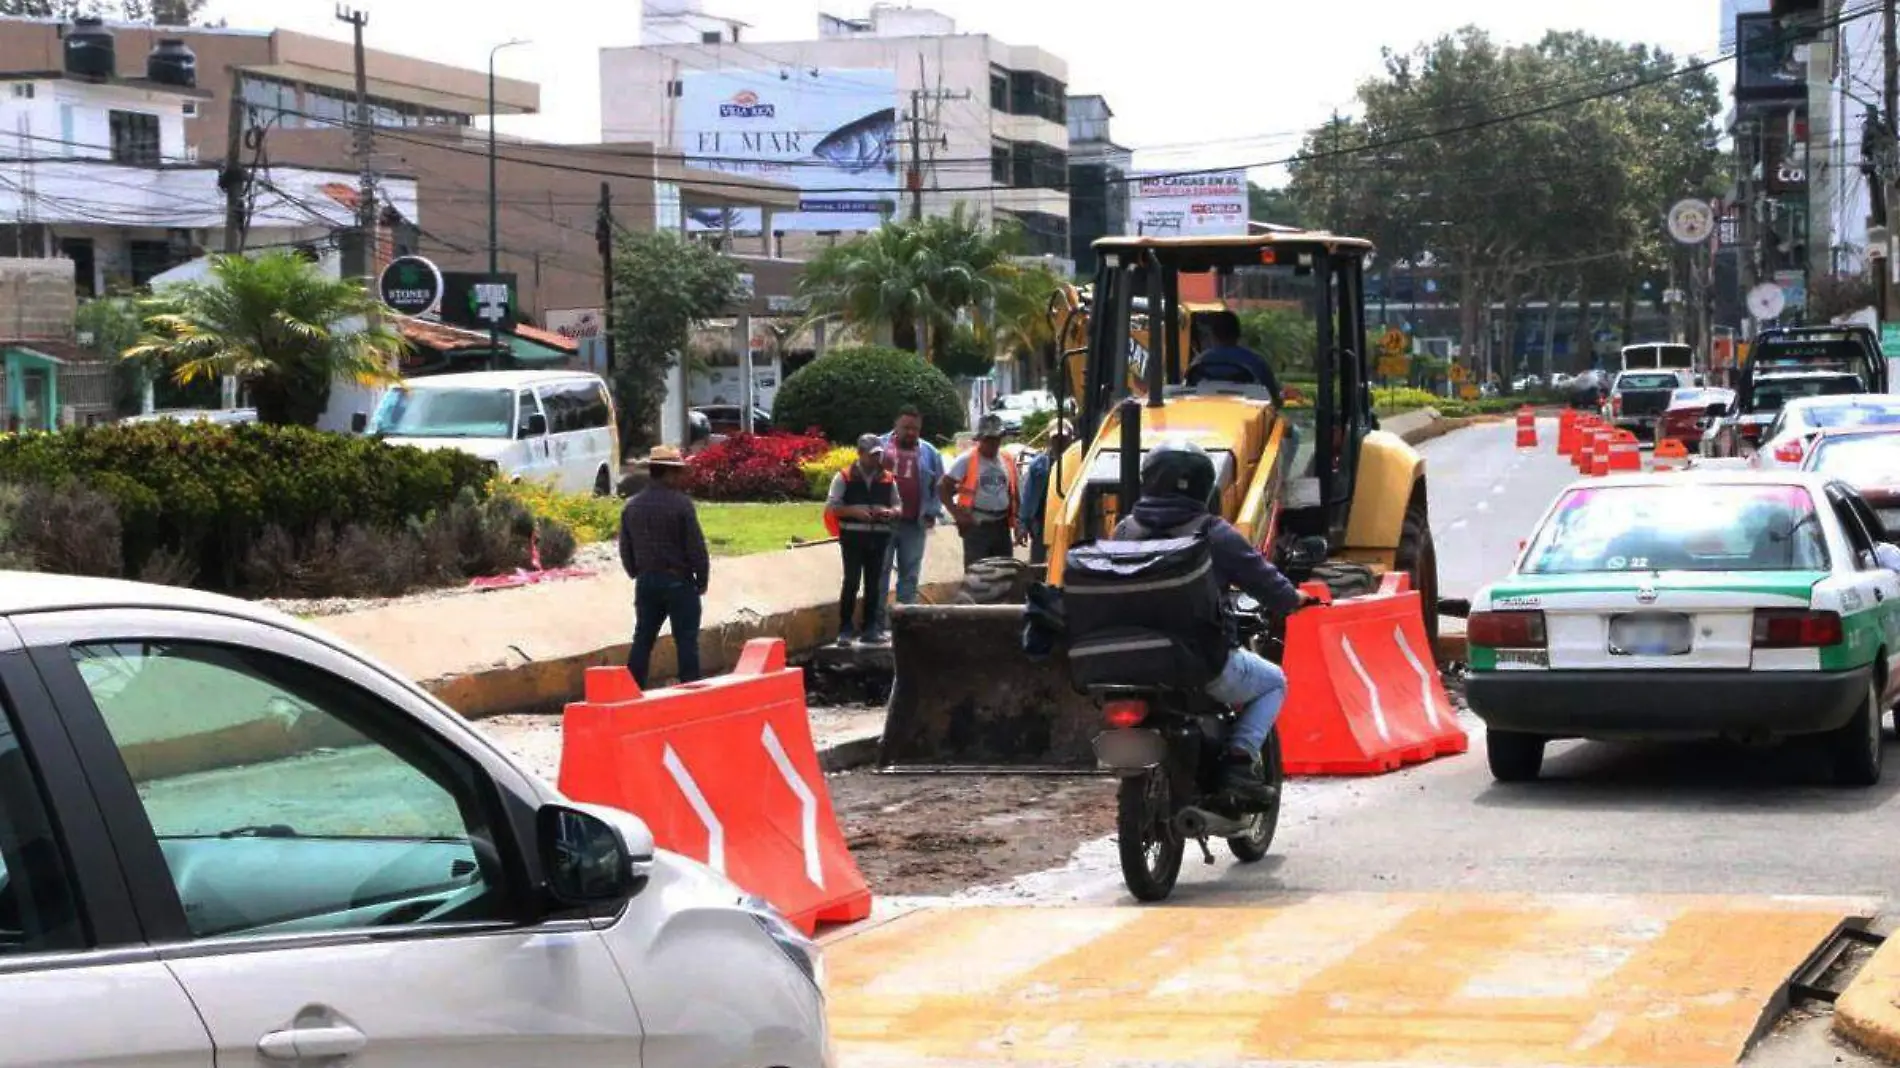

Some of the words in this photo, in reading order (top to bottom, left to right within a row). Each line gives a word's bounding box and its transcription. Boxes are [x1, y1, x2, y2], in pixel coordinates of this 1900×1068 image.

[699, 132, 720, 152] EL
[742, 132, 800, 152] MAR
[1164, 176, 1206, 186] CAIGAS
[1208, 176, 1223, 185] EN
[1630, 557, 1649, 567] 22
